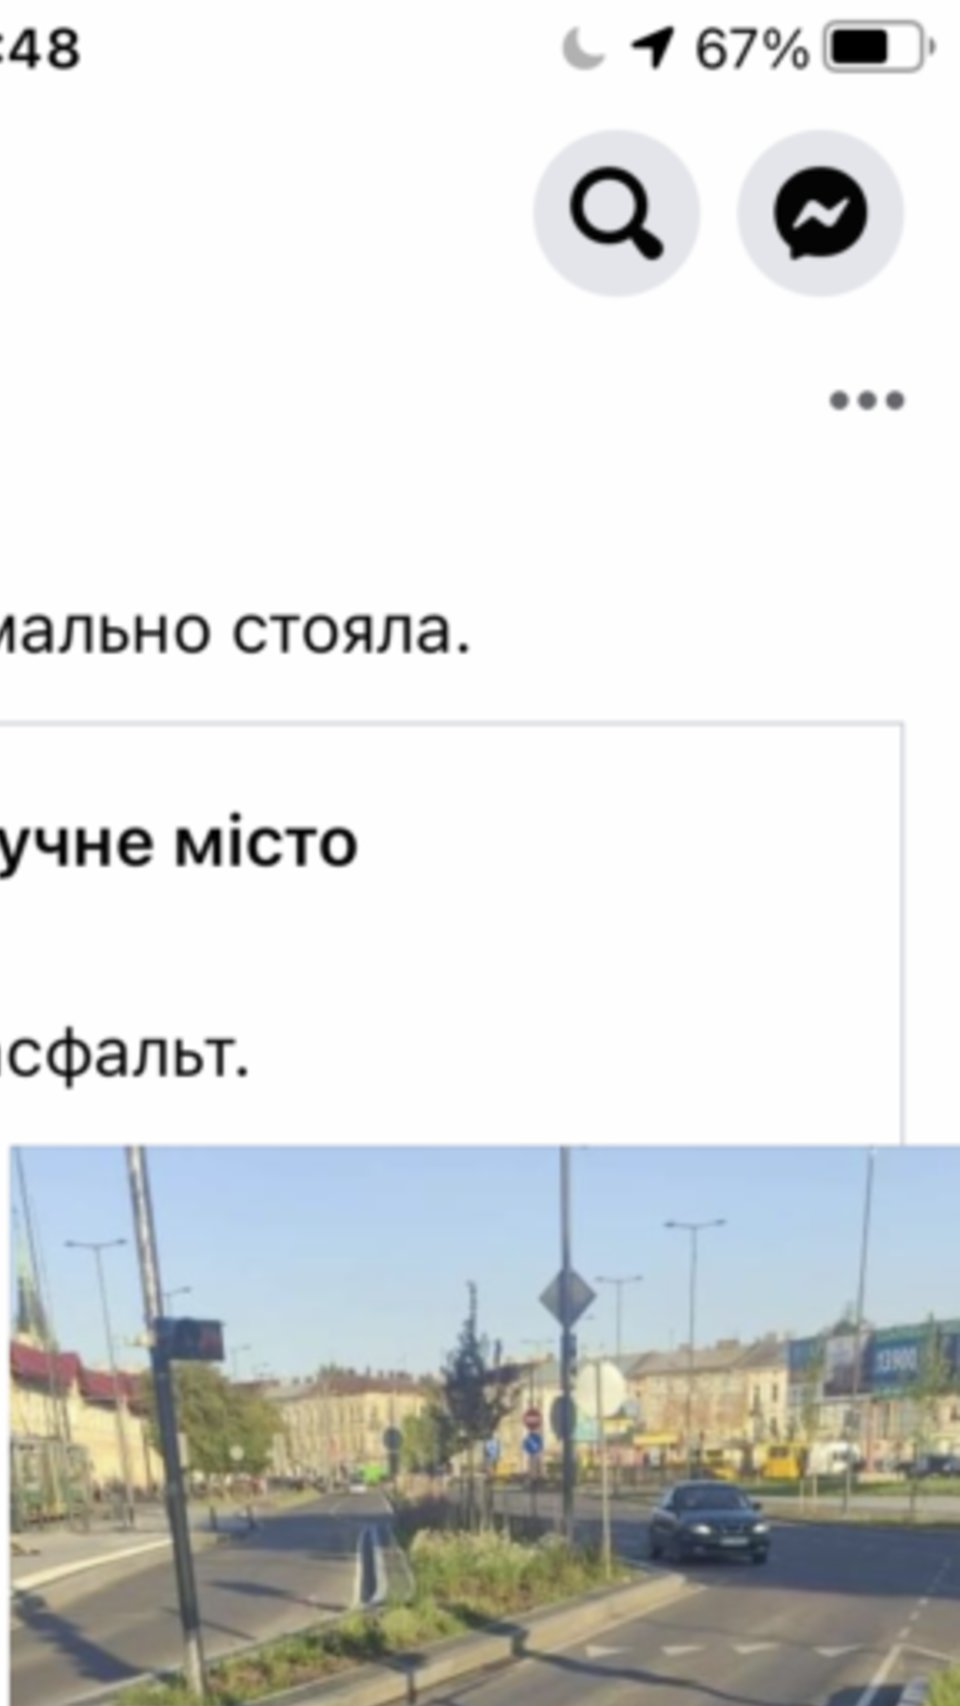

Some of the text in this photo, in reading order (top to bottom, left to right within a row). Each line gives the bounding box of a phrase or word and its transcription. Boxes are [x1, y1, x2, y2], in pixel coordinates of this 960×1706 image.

[695, 26, 810, 71] 67%
[233, 613, 470, 654] стояла.
[176, 811, 358, 868] місто
